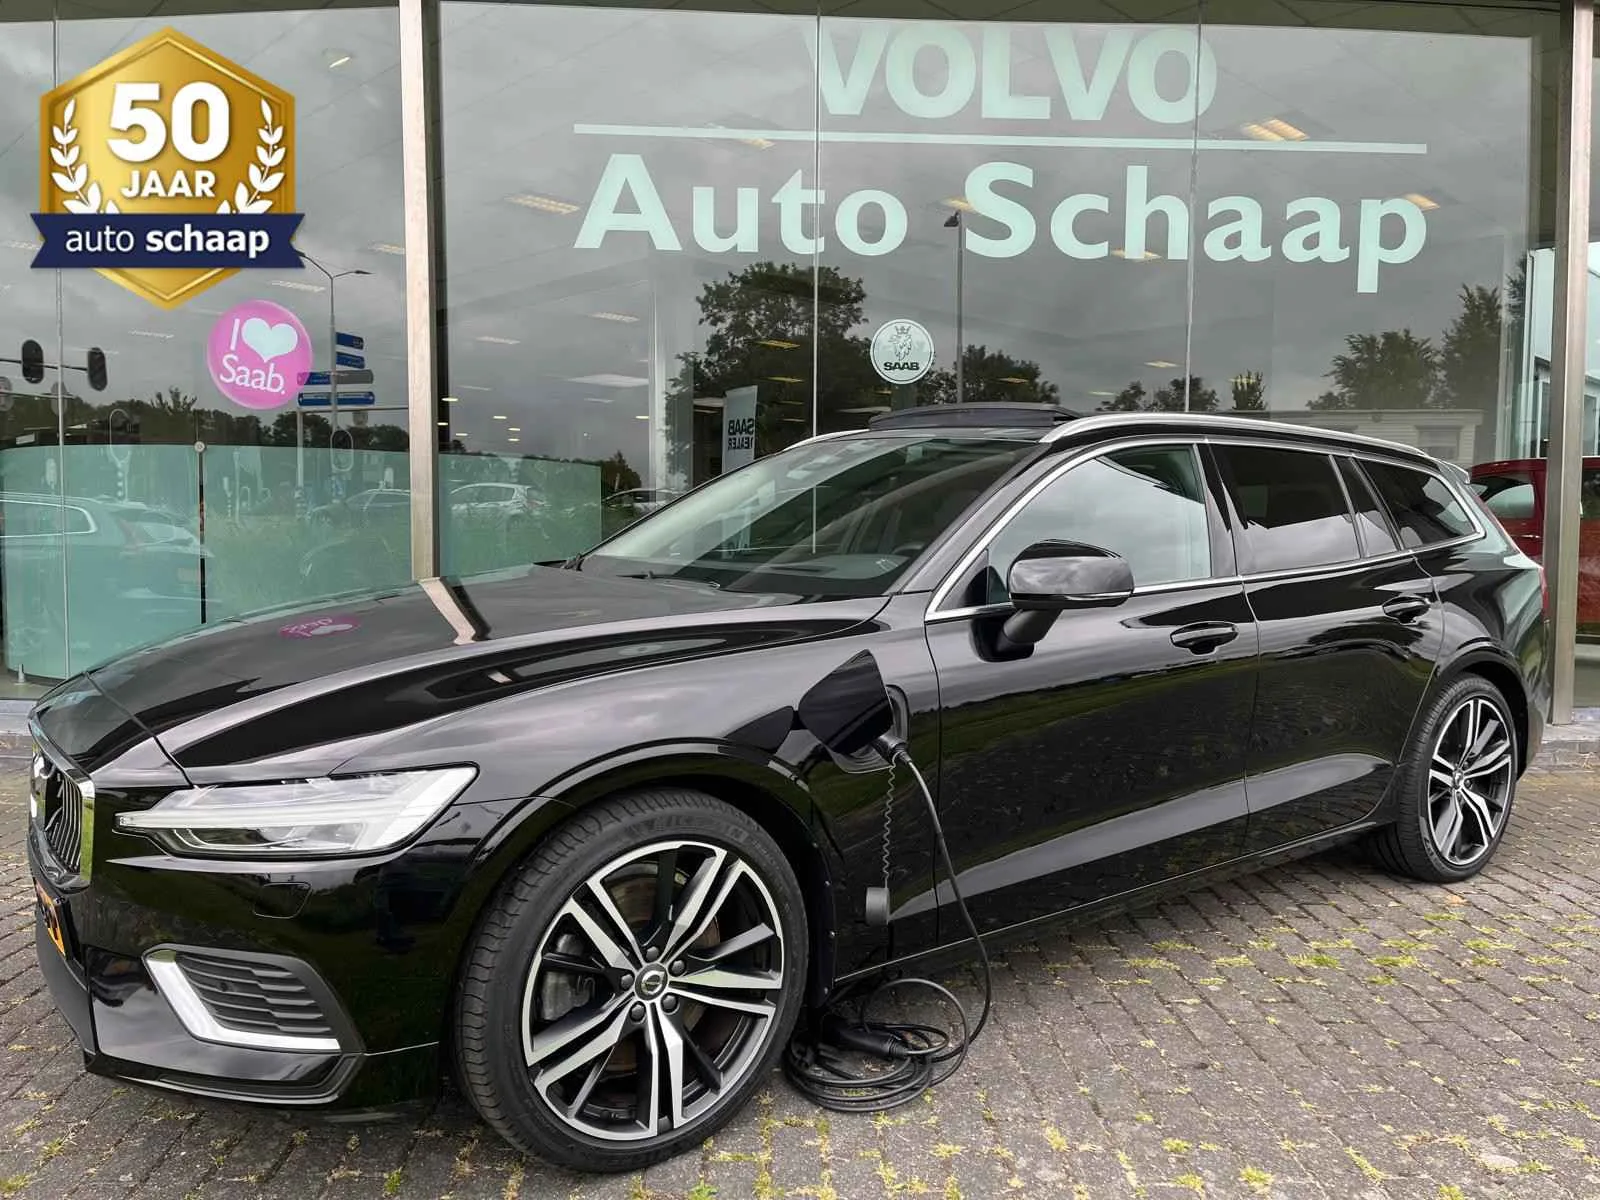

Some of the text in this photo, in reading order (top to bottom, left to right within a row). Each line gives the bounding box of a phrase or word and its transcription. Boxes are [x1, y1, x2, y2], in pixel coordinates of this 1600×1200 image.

[804, 24, 1217, 123] VOLVO
[573, 153, 1427, 293] Auto Schaap
[229, 318, 241, 352] I
[883, 361, 920, 371] SAAB
